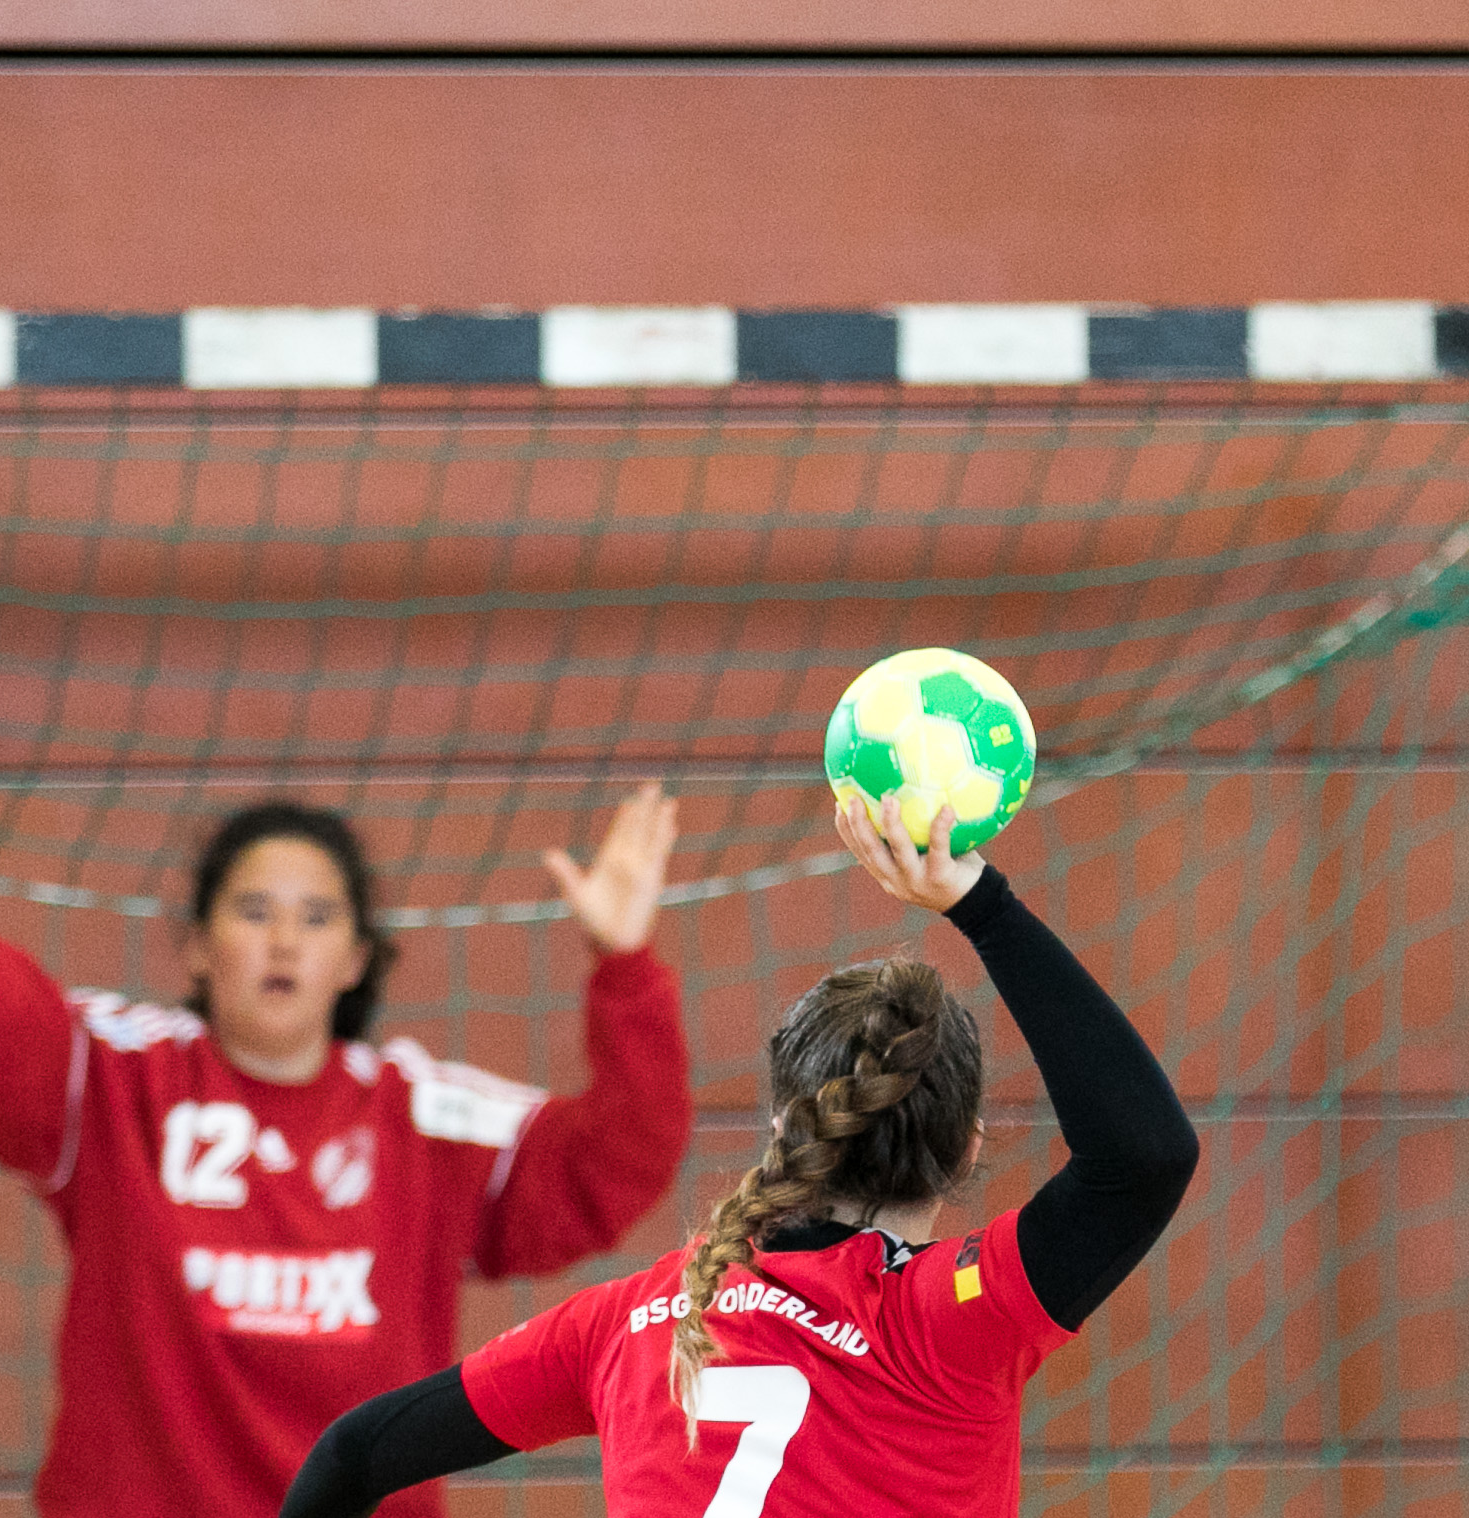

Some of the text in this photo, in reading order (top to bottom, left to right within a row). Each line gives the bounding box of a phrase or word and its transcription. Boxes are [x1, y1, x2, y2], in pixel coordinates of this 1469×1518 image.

[162, 1101, 258, 1209] 12
[629, 1282, 871, 1358] BSG ODERLAND
